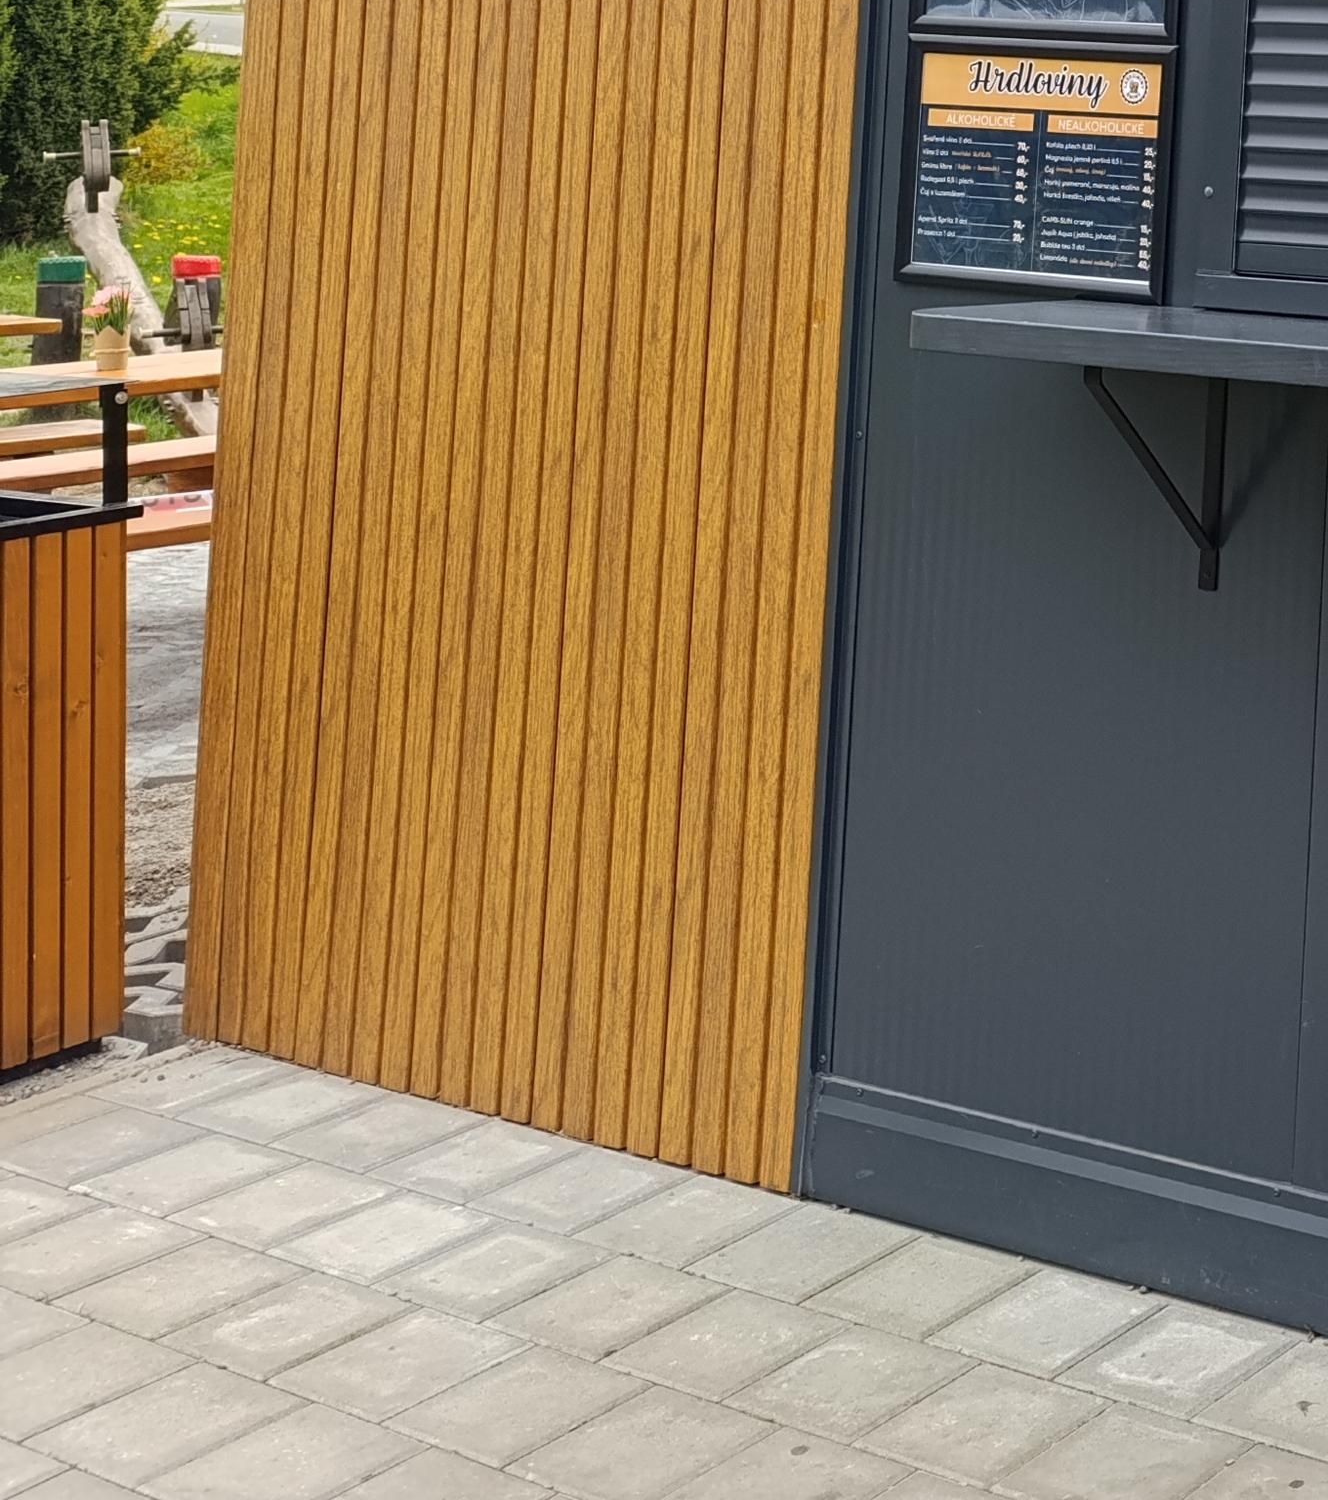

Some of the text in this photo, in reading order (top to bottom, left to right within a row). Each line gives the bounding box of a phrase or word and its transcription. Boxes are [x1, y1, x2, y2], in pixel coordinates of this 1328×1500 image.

[969, 61, 1108, 109] Hrdloviny
[946, 113, 1016, 127] ALKOHOLICKÉ
[1058, 119, 1145, 135] NEALKOHOLICKÉ
